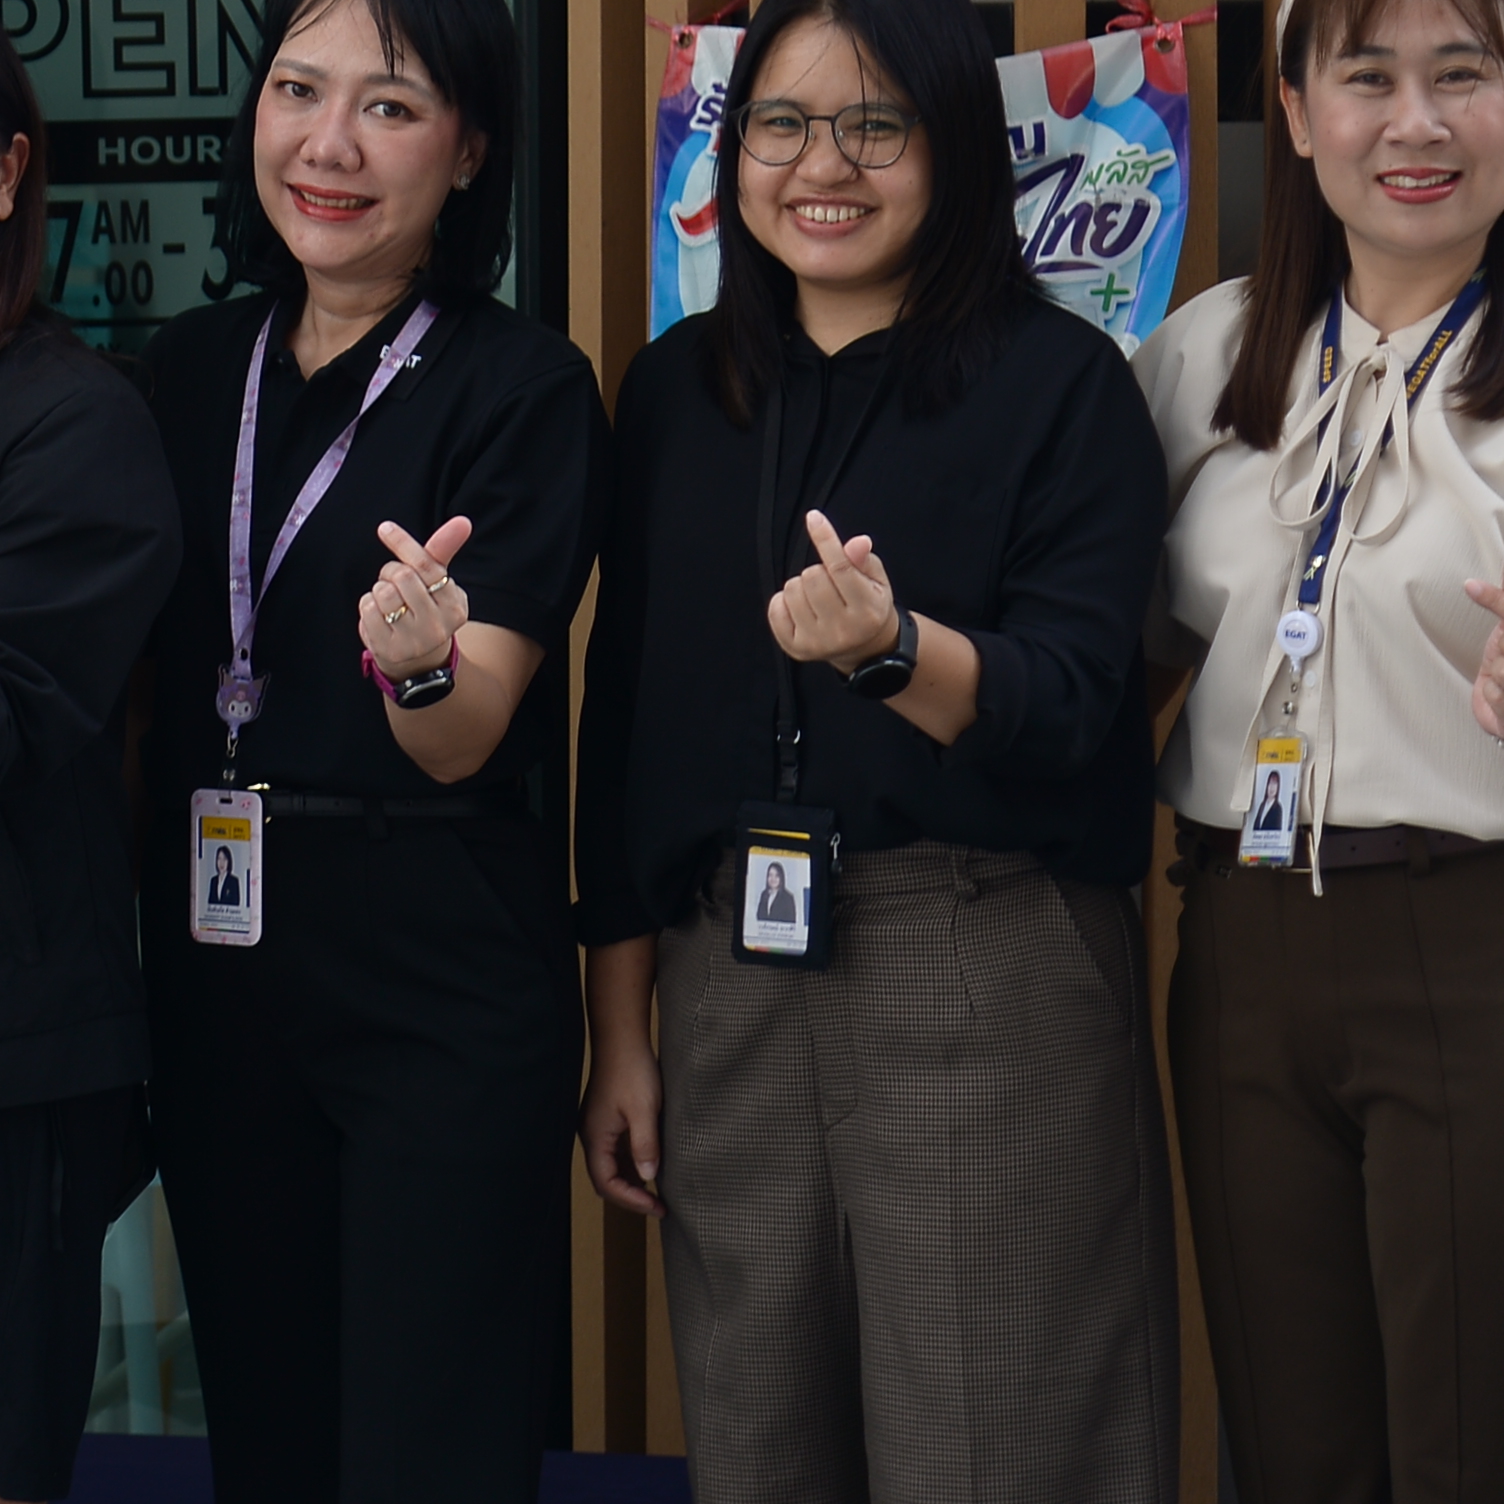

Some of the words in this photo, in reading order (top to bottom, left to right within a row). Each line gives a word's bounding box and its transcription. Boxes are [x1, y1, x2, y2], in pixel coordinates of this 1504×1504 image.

[97, 134, 232, 166] HOUR
[91, 200, 152, 245] AM
[1285, 630, 1306, 640] EGAT
